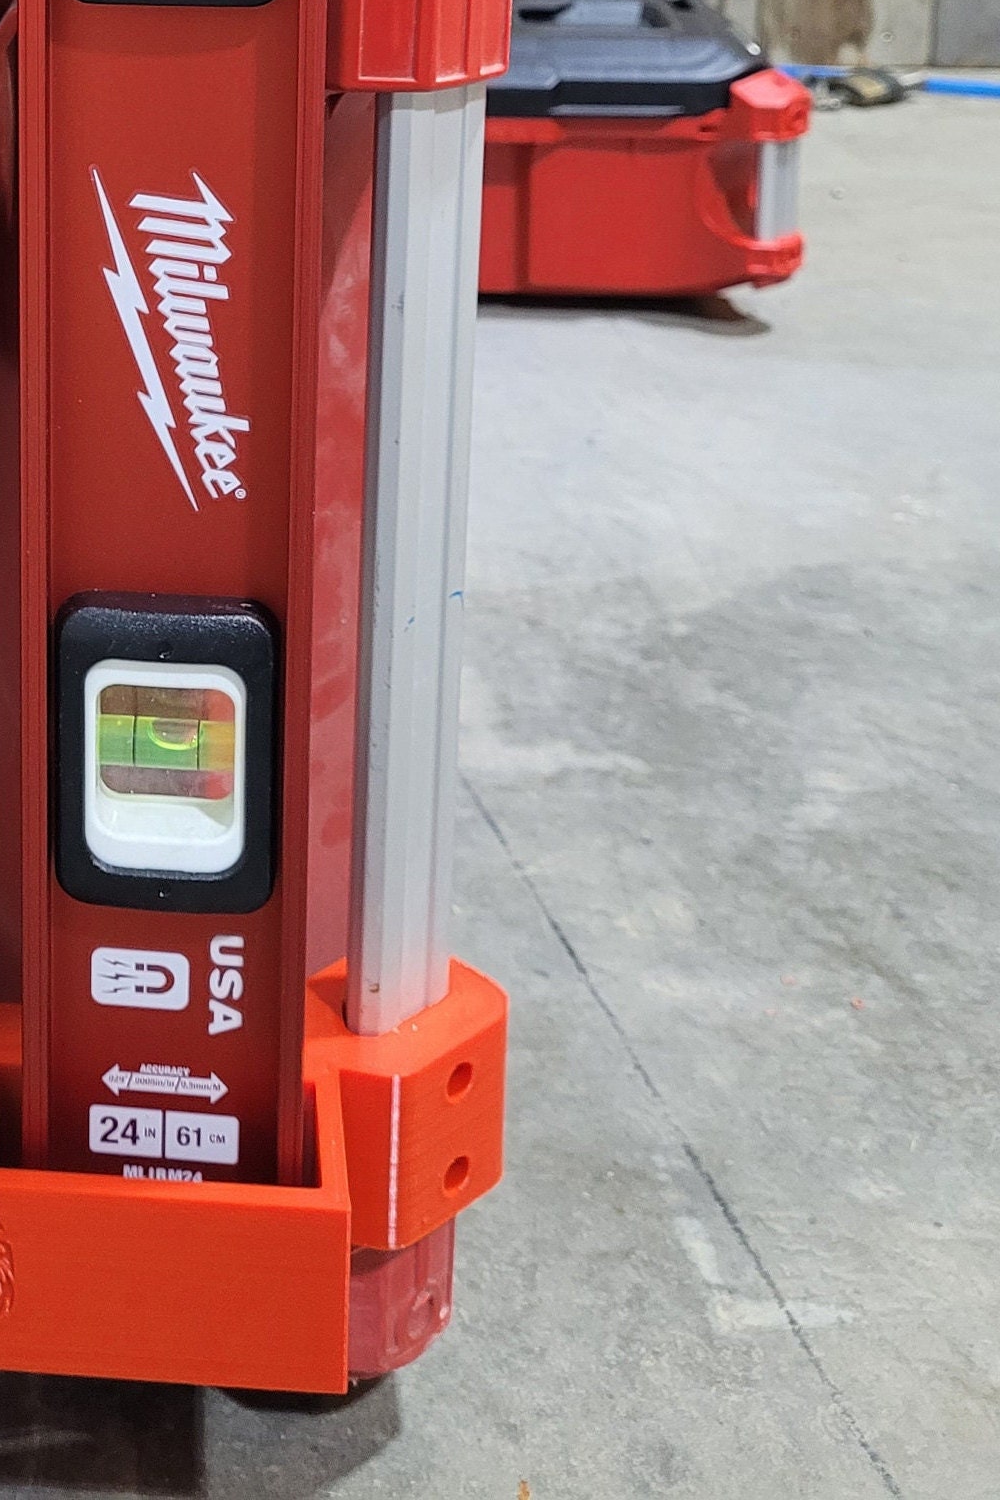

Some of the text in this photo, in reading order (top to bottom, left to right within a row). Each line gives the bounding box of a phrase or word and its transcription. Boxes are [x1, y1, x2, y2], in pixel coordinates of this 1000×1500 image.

[128, 170, 250, 499] Milwaukee
[207, 934, 245, 1036] USA
[100, 1116, 156, 1146] 24 IN
[176, 1126, 226, 1147] 61 CM
